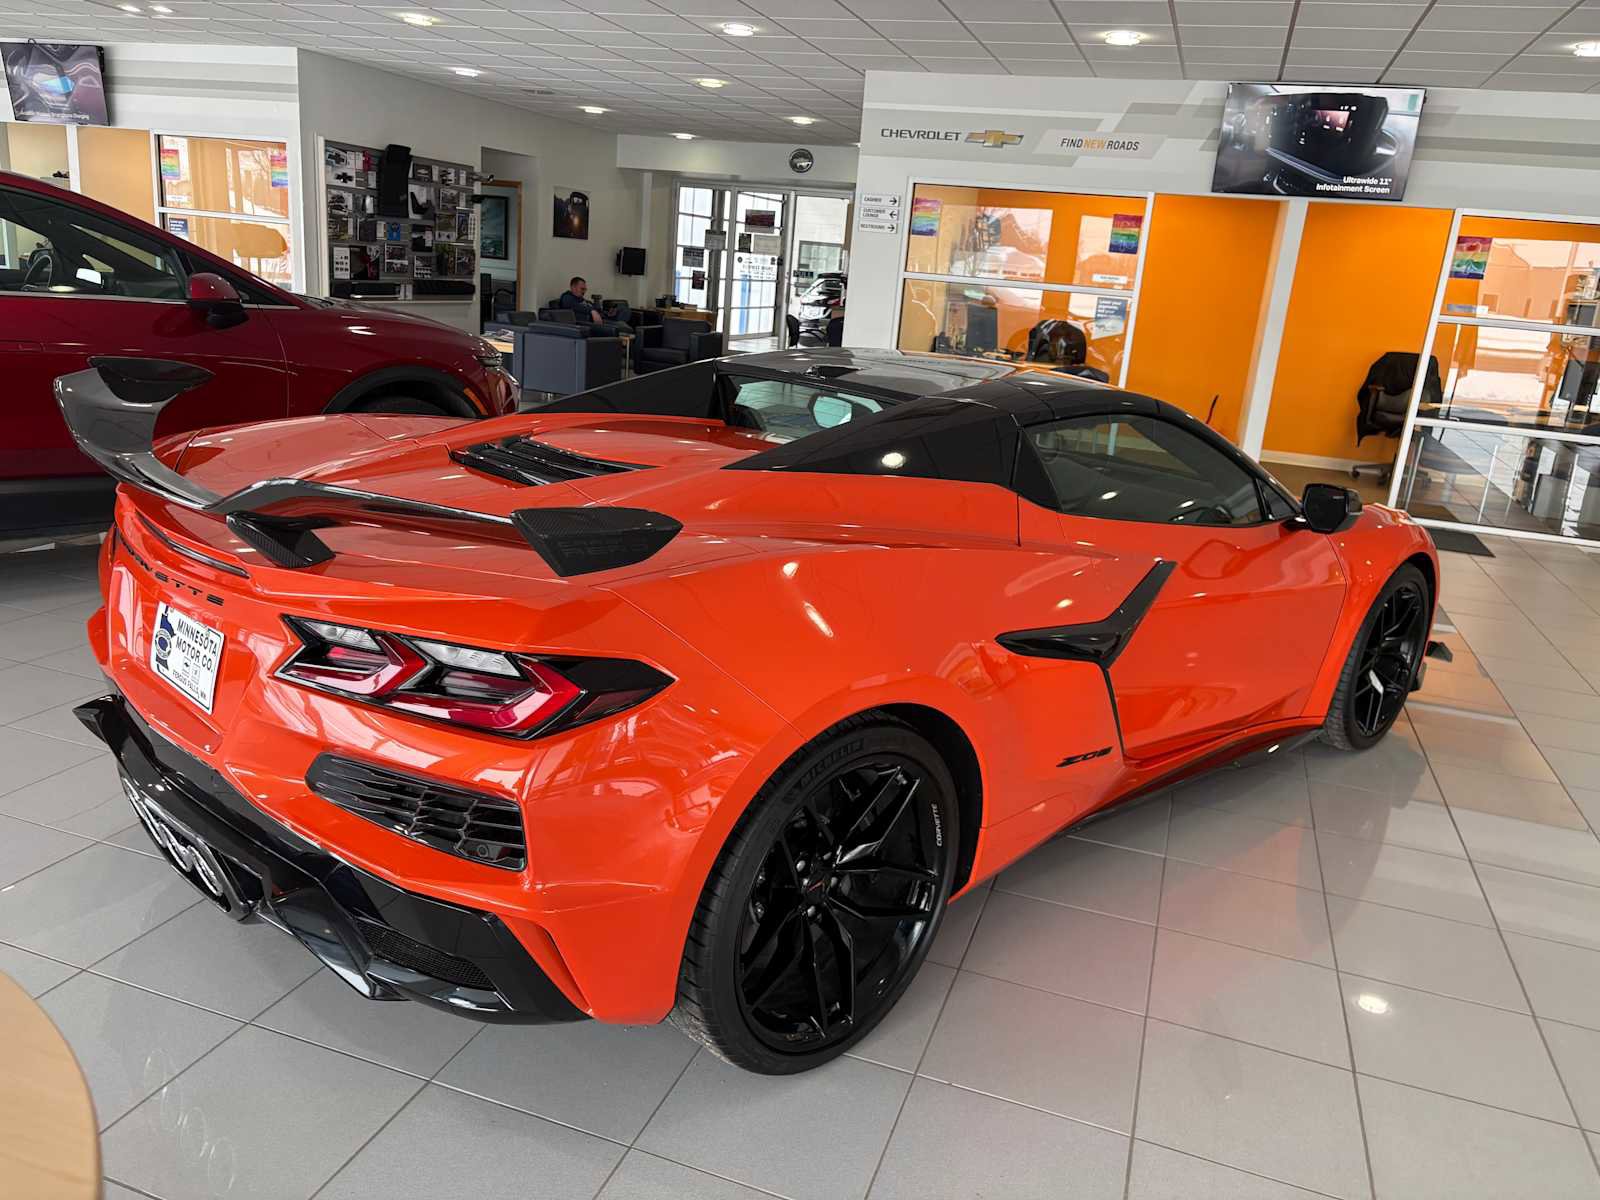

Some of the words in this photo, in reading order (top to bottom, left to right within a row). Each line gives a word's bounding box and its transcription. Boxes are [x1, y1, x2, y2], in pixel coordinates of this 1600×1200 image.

[880, 127, 962, 142] CHEVROLET
[1106, 140, 1140, 151] ROADS
[1342, 176, 1379, 185] Ultrawide
[1316, 183, 1363, 193] Infotainment
[1363, 185, 1391, 194] Screen
[176, 618, 218, 657] MINNESOTA
[175, 635, 201, 664] MOTOR
[201, 655, 214, 673] CO.
[930, 803, 943, 847] CORVETTE
